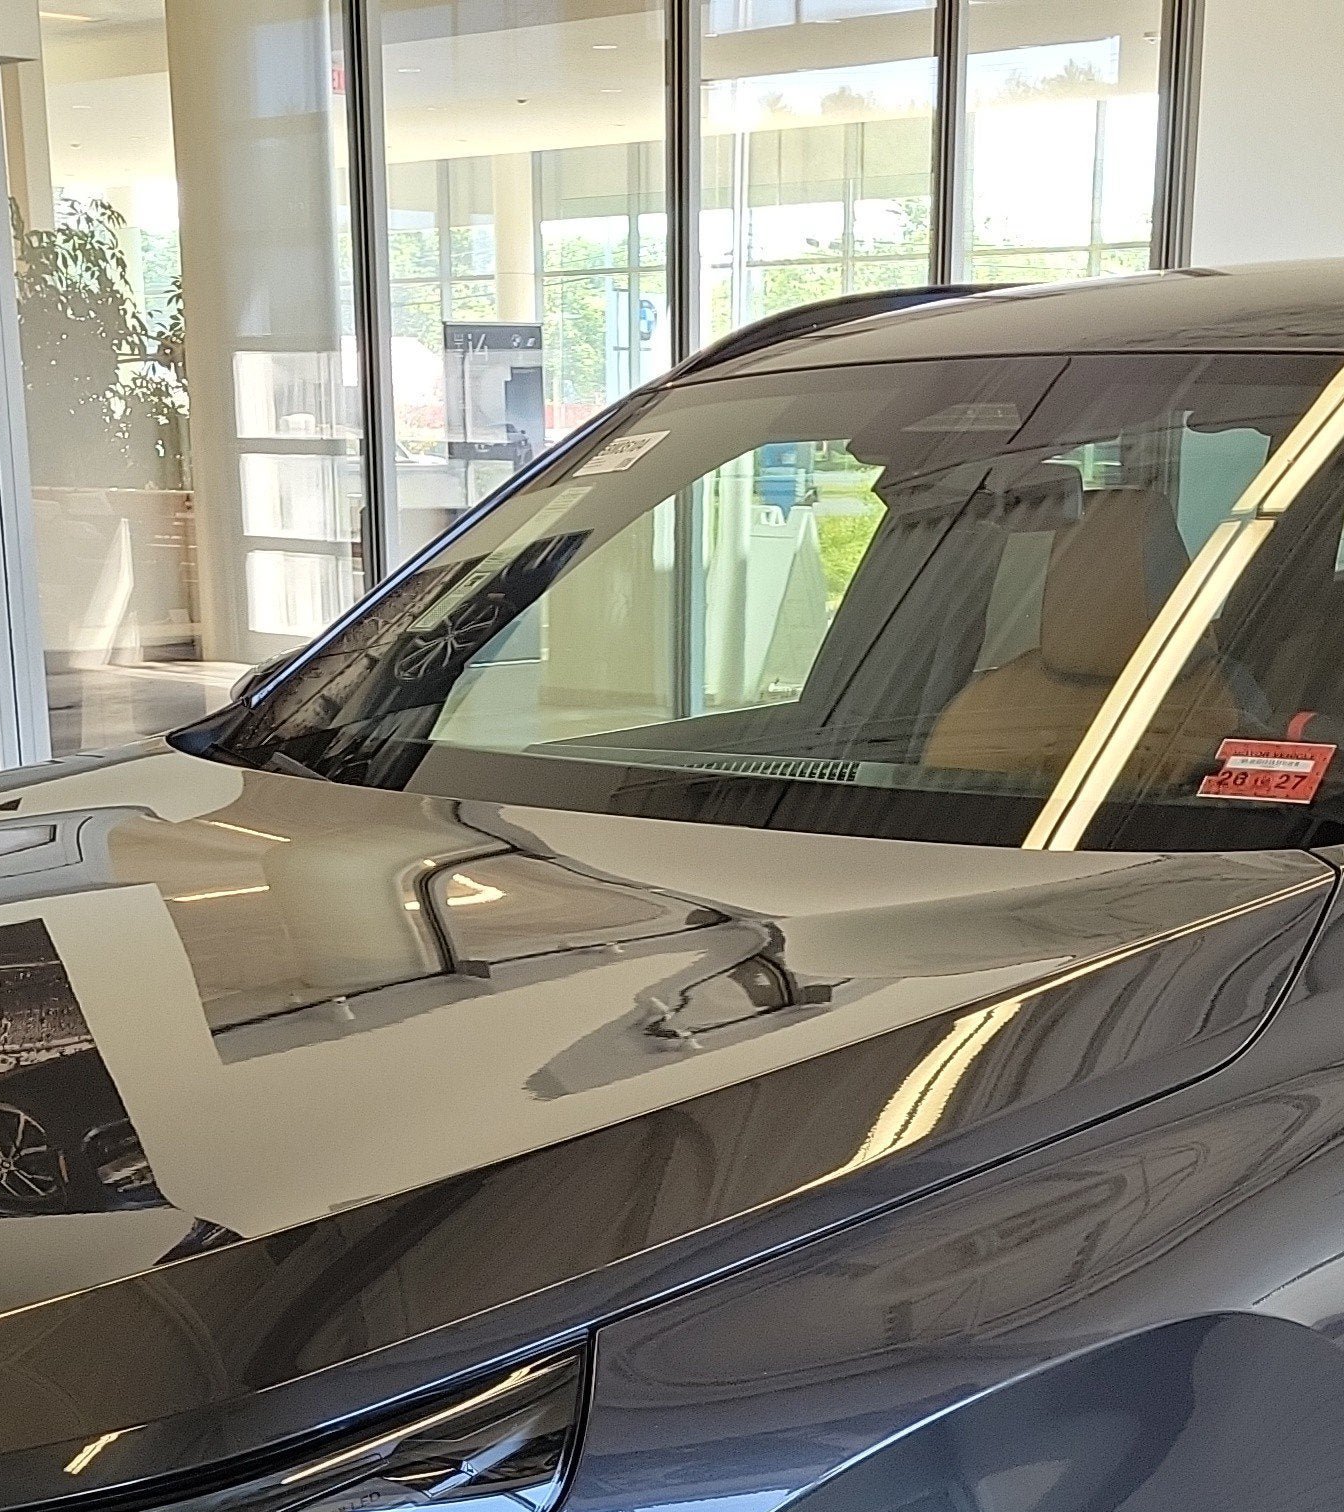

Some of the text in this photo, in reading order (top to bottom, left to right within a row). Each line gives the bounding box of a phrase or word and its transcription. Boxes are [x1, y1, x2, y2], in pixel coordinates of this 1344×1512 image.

[467, 333, 488, 361] i4
[1275, 774, 1308, 790] 27
[350, 1491, 381, 1510] LED
